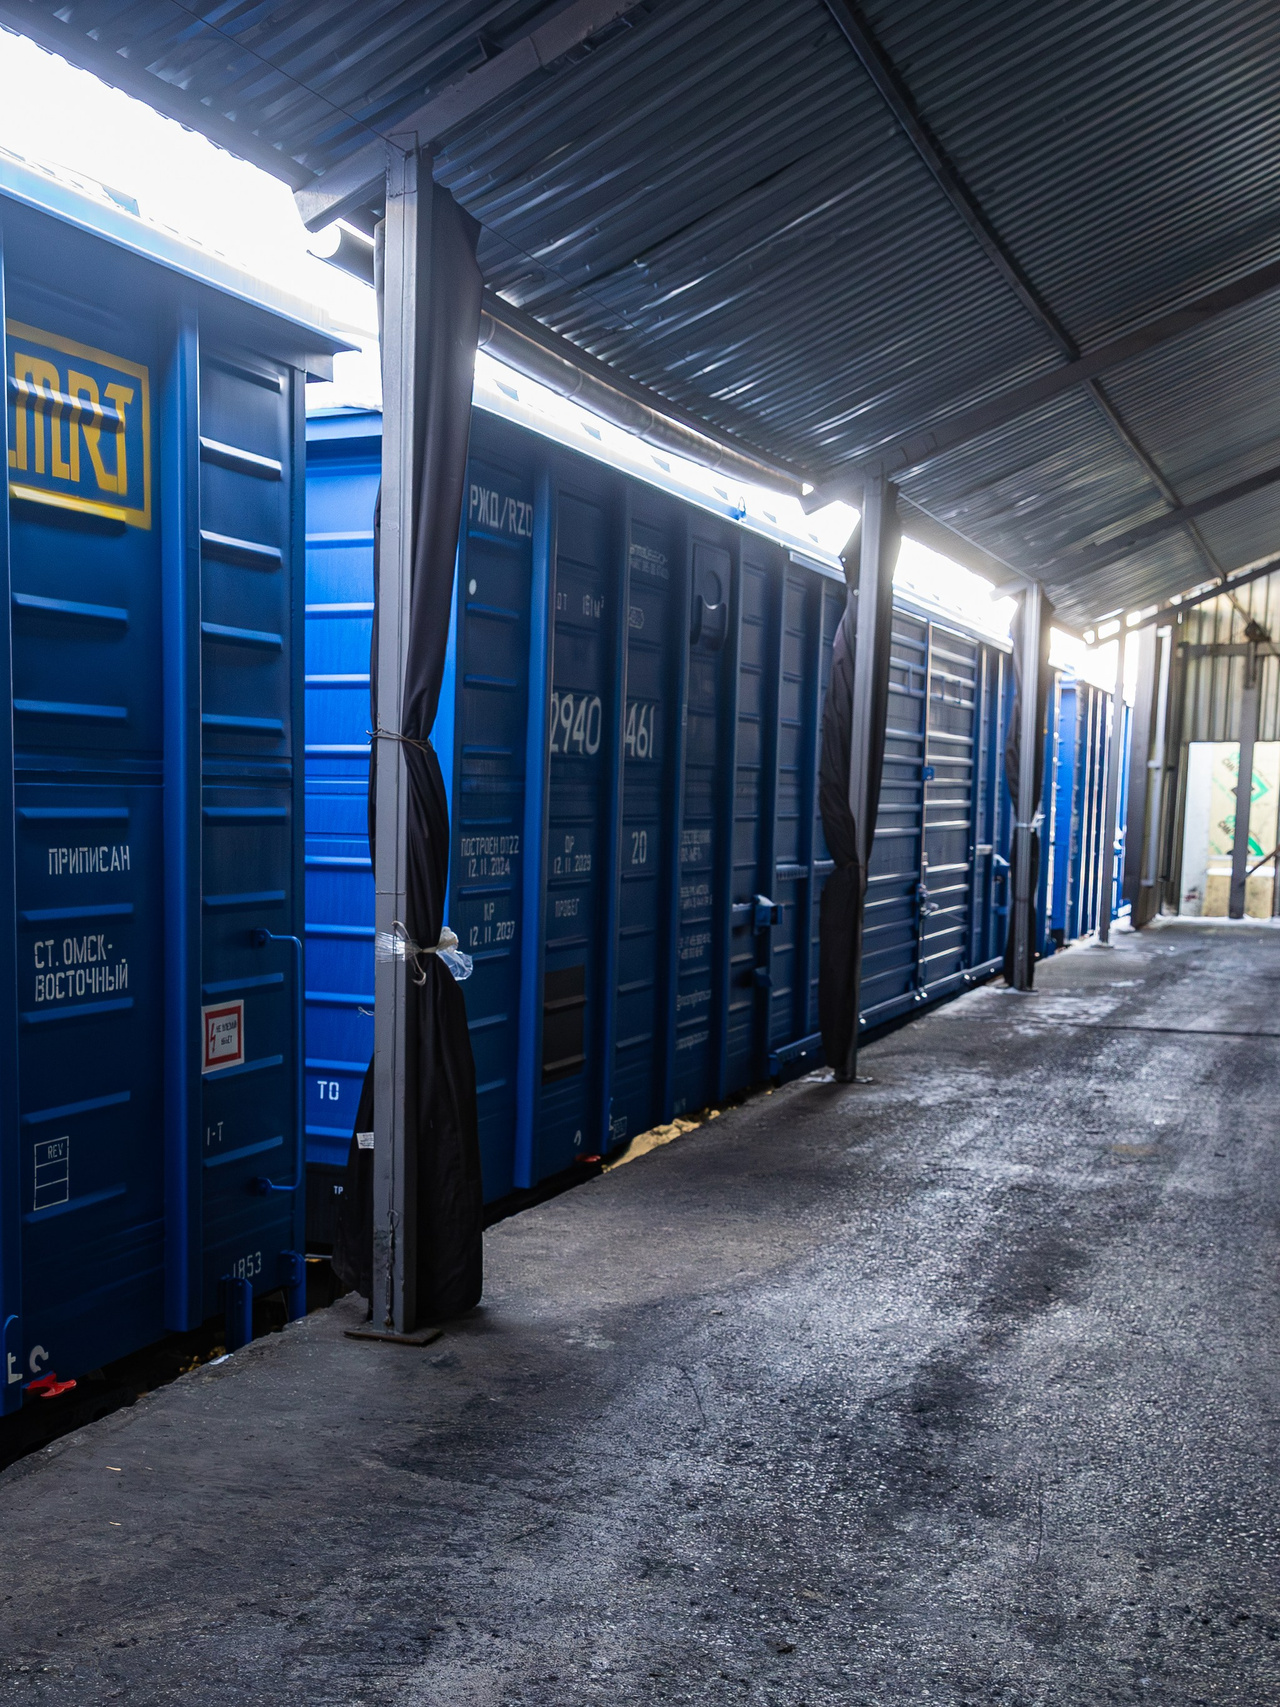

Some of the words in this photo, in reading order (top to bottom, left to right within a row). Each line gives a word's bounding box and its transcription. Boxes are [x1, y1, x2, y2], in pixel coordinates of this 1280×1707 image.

[48, 845, 131, 876] ПРИПИСАН
[461, 836, 499, 857] ПОСТРОЕН
[631, 830, 648, 865] 20
[35, 959, 129, 1003] ВОСТОЧНЫЙ
